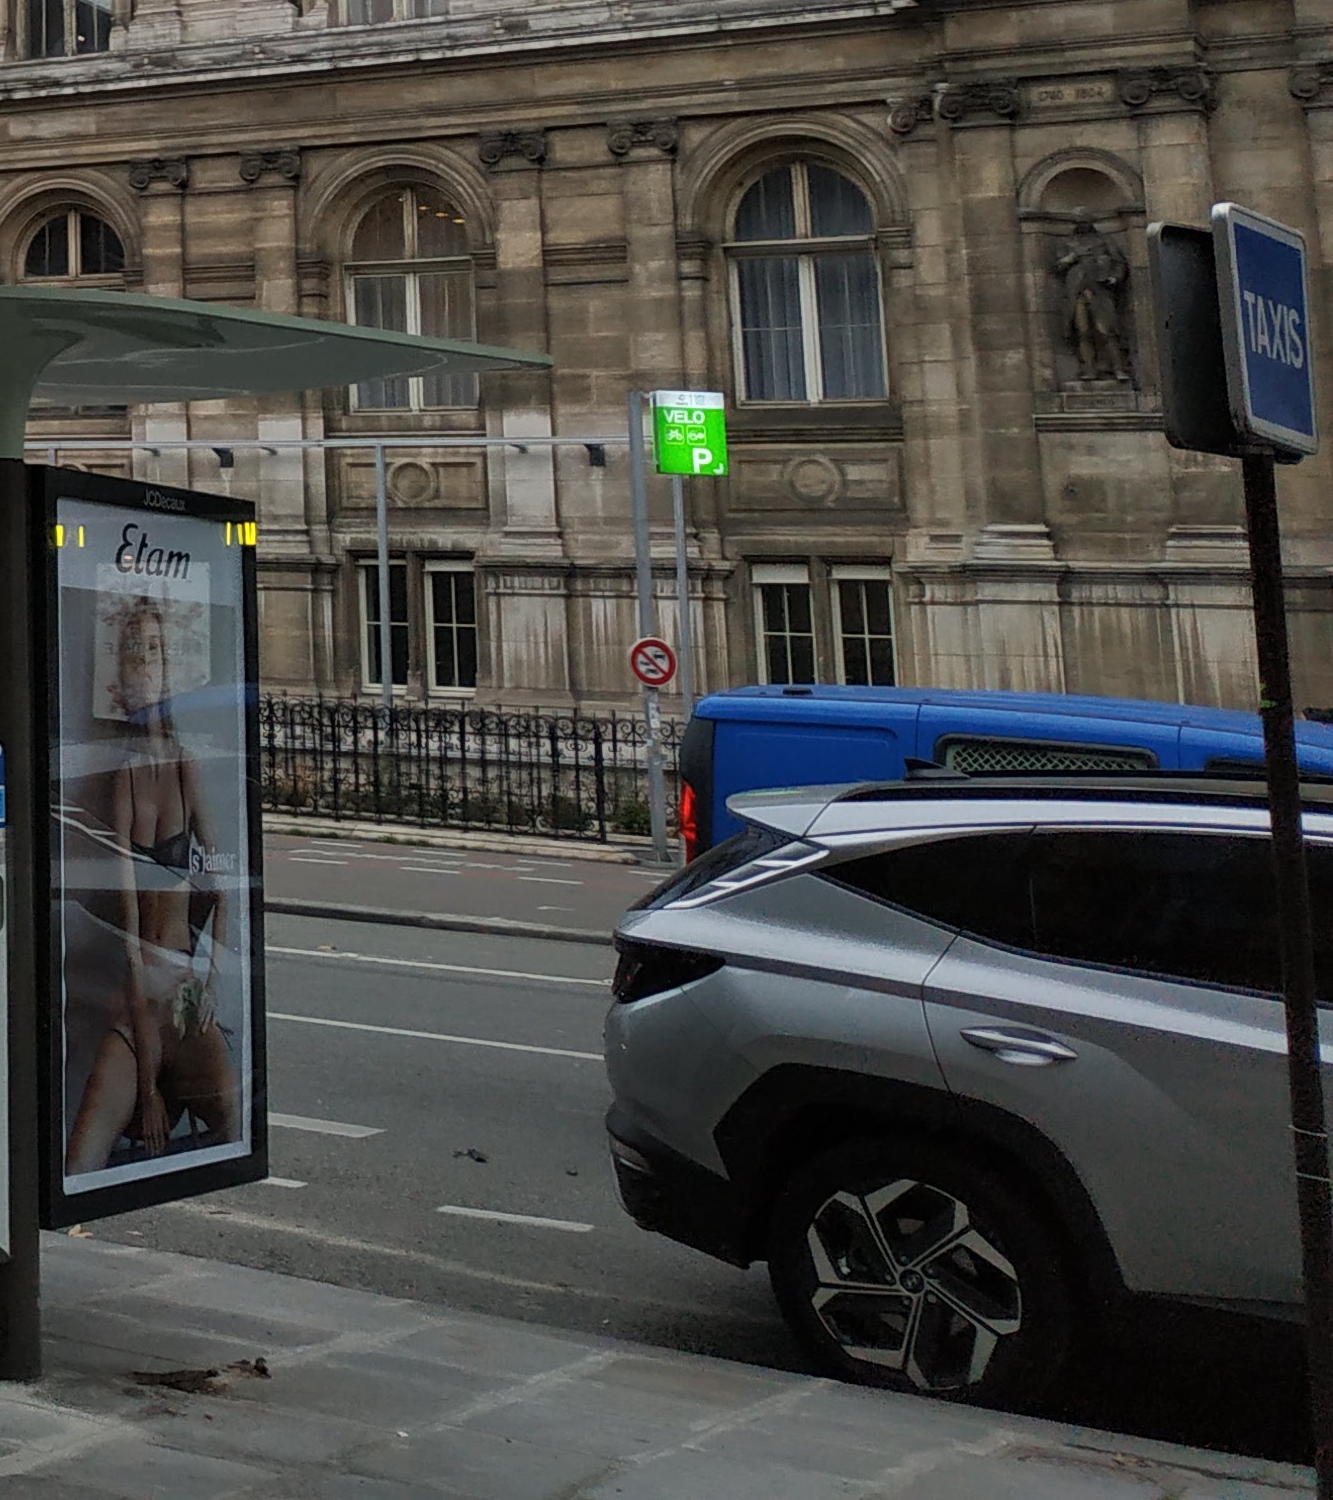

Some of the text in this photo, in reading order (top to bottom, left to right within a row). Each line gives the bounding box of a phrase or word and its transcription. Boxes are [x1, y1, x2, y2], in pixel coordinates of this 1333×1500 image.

[1243, 290, 1304, 370] TAXIS
[663, 408, 706, 425] VELO
[692, 447, 713, 474] P
[143, 488, 187, 512] JCDecaux
[115, 522, 191, 580] Etam
